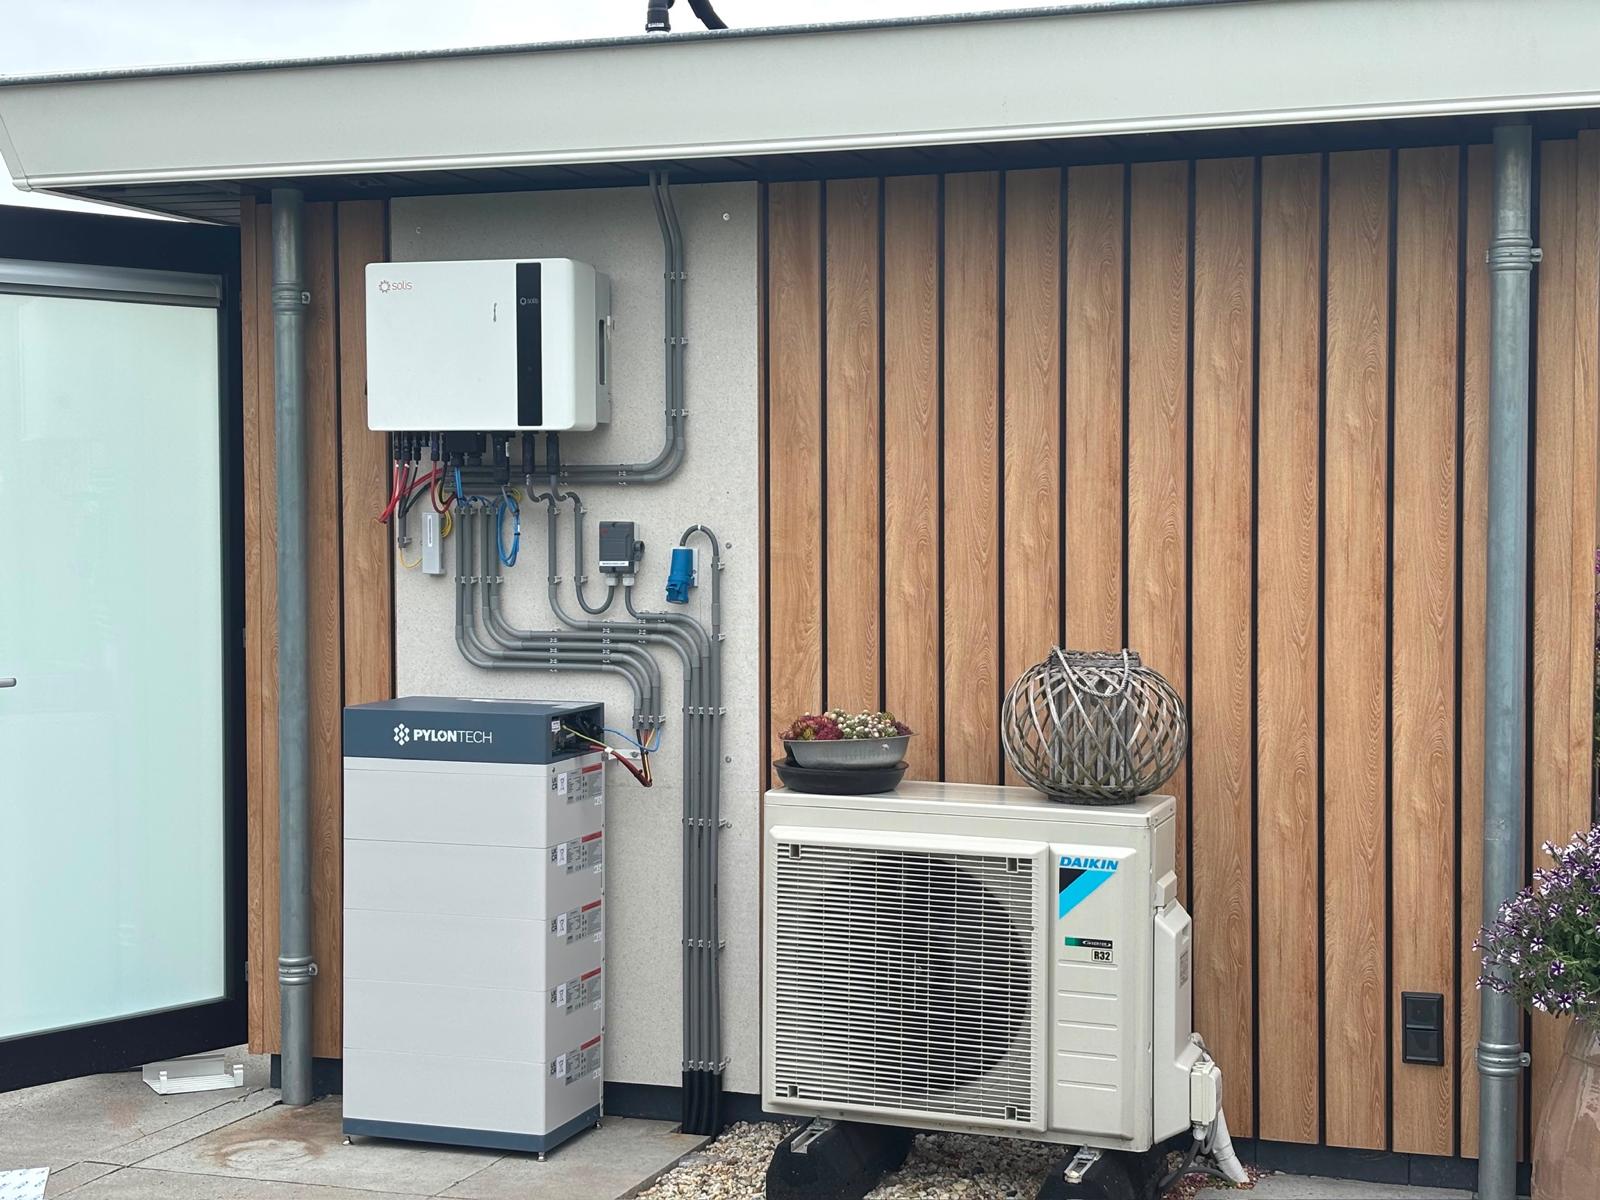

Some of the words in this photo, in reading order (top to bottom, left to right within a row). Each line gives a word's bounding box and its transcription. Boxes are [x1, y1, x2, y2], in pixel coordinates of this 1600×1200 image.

[392, 280, 413, 290] solis
[413, 728, 493, 744] PYLONTECH
[1059, 856, 1119, 870] DAIKIN
[1094, 951, 1111, 961] R32
